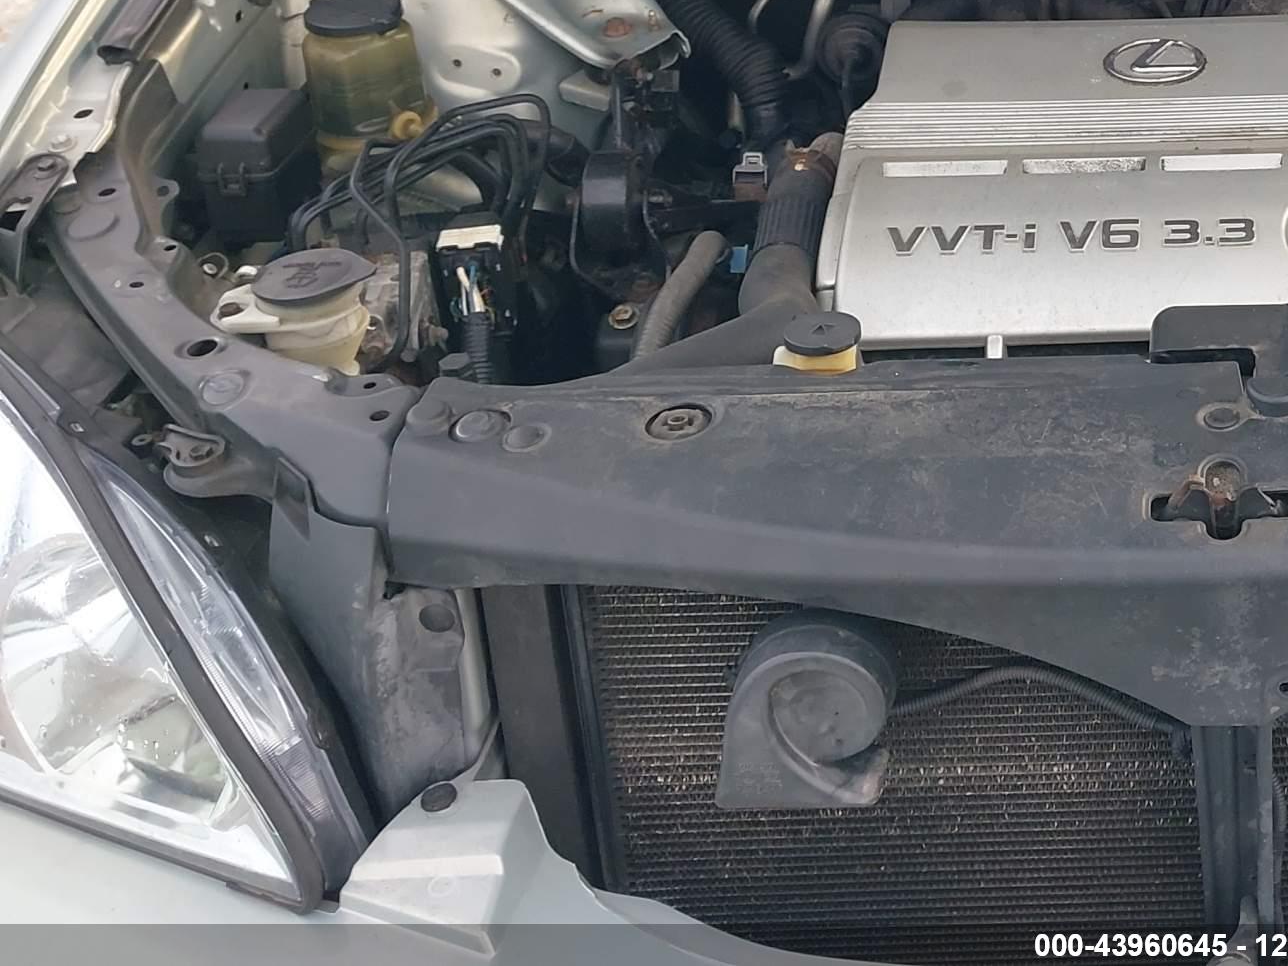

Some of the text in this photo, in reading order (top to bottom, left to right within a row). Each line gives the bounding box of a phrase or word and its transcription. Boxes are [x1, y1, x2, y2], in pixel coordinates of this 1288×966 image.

[887, 218, 1256, 254] VVT-i V6 3.3
